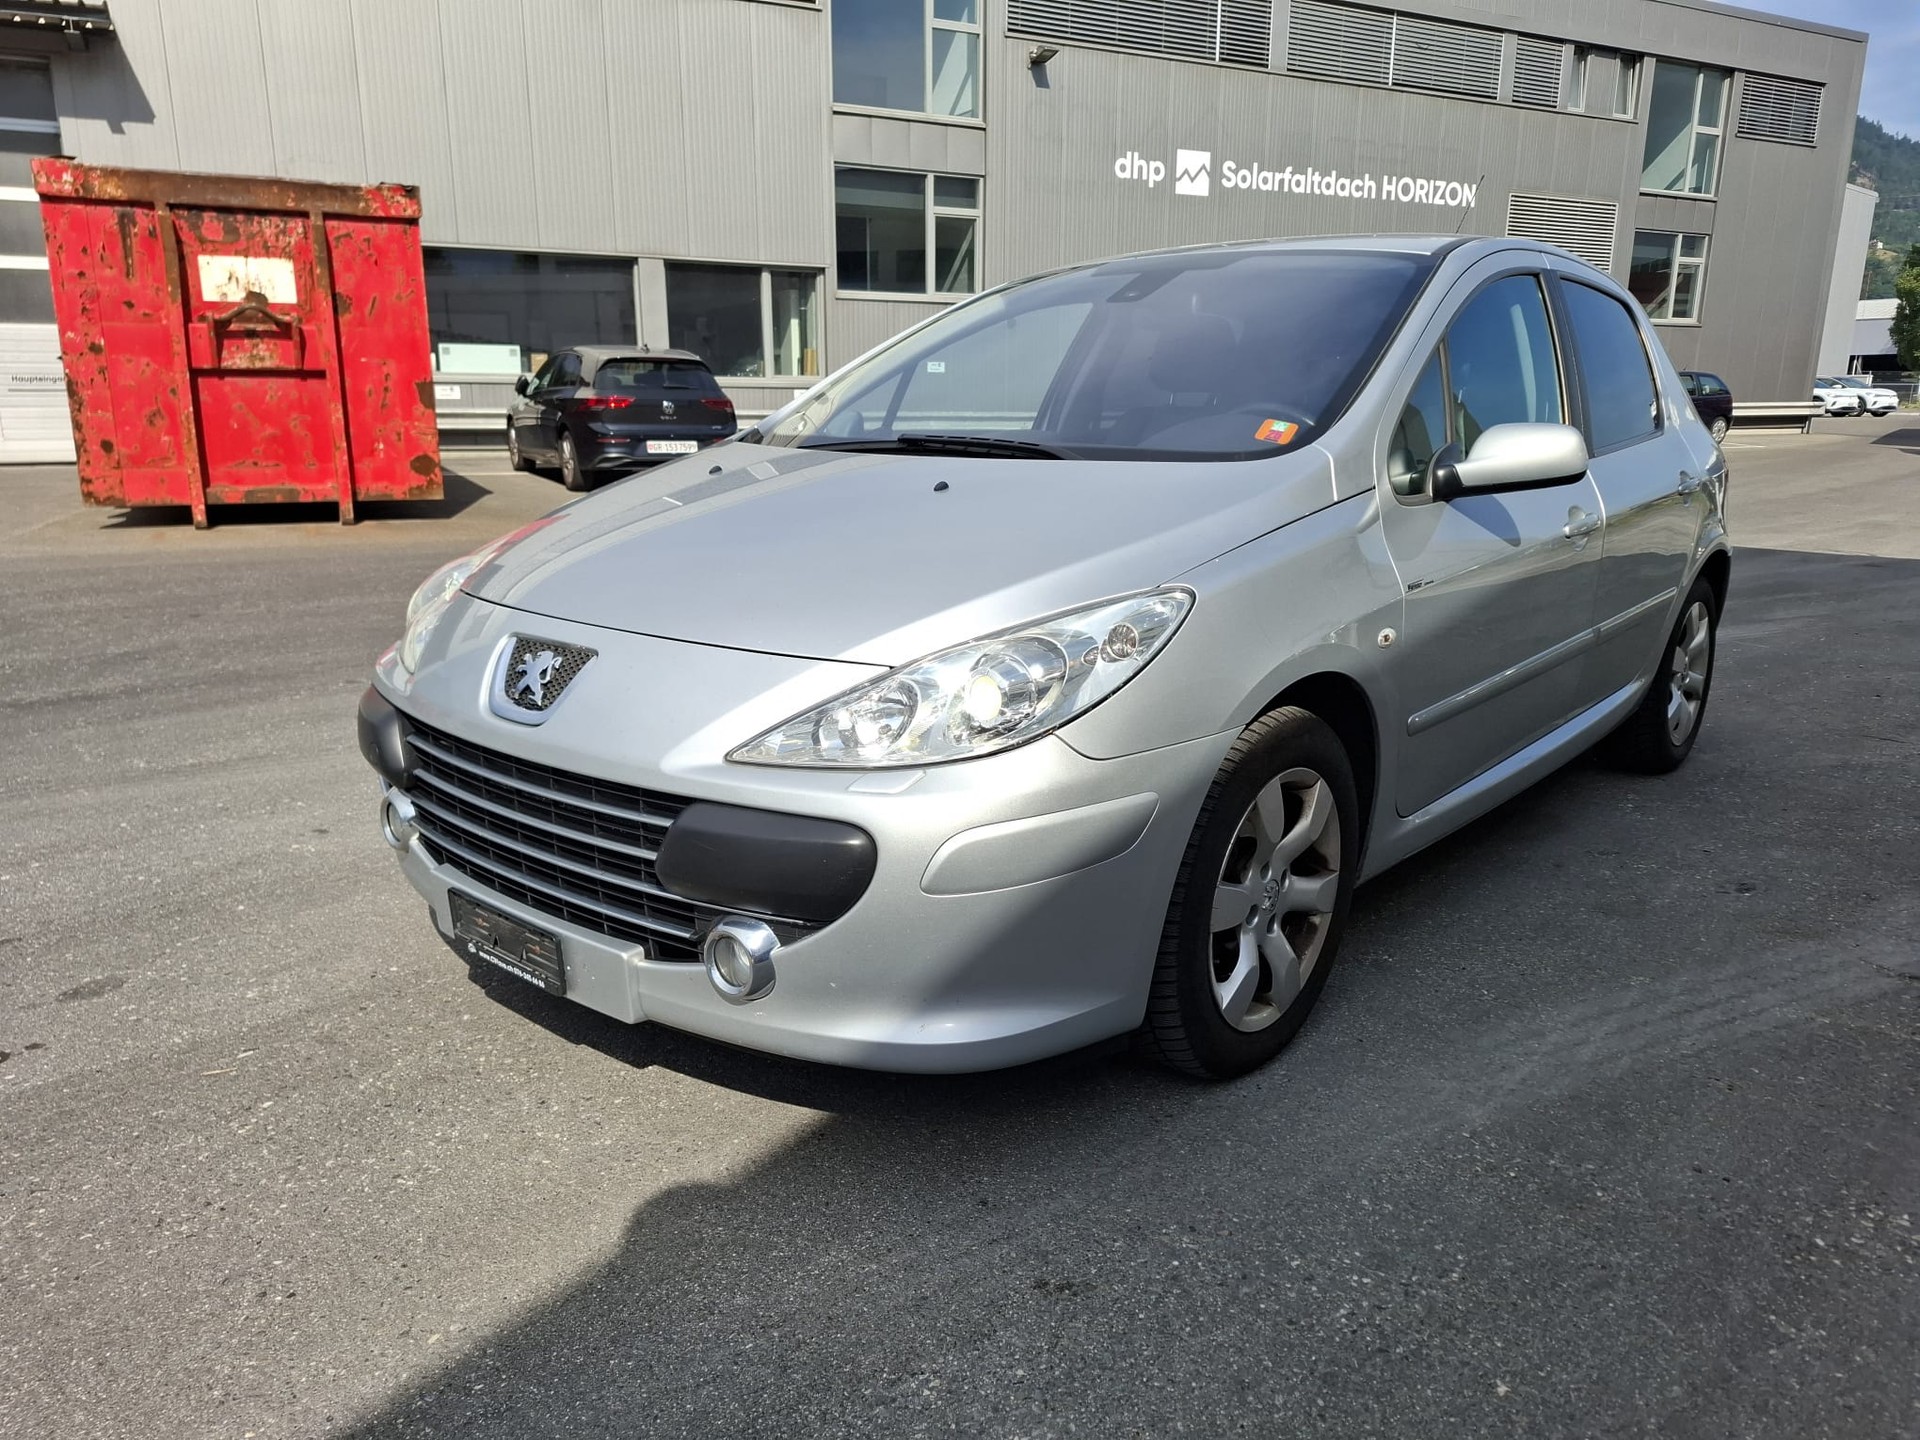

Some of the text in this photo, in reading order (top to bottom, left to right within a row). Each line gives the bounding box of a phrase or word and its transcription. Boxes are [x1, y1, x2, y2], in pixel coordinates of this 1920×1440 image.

[1114, 151, 1166, 188] dhp
[1221, 160, 1477, 208] Solarfaltdach HORIZON
